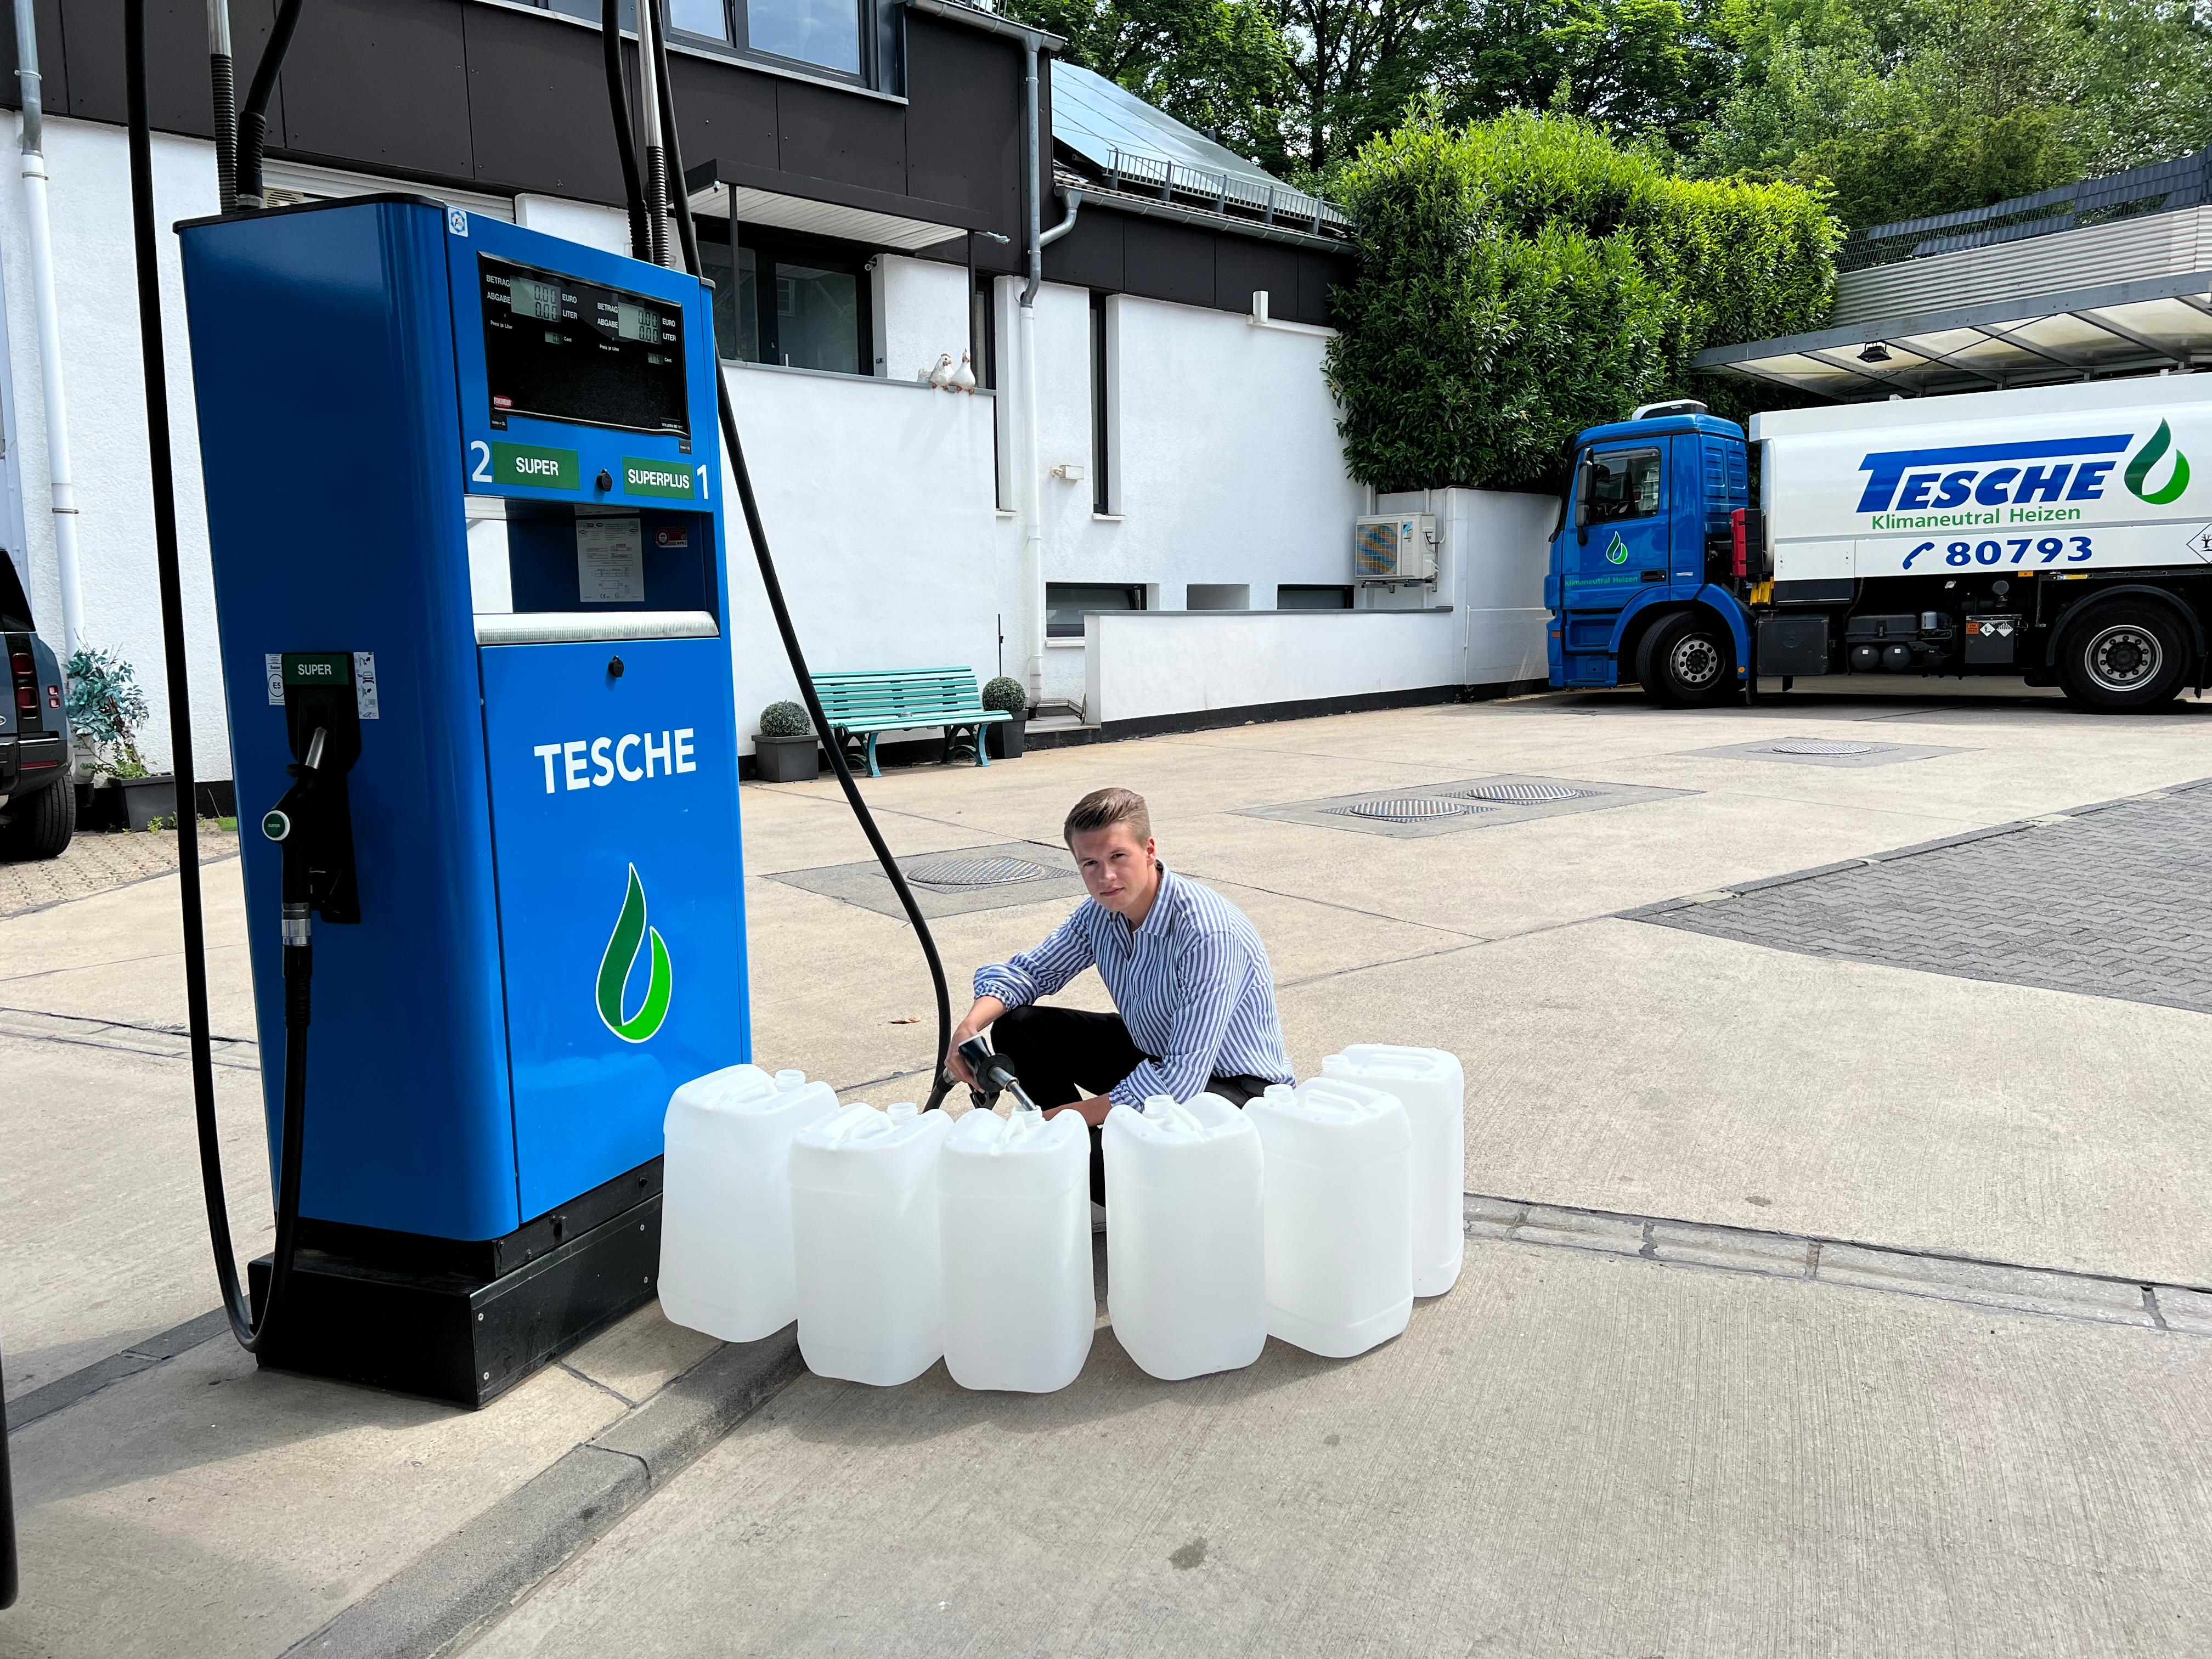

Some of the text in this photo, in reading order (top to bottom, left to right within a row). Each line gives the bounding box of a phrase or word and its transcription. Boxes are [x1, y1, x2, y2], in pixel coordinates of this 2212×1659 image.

[486, 274, 510, 287] BETRAG
[562, 293, 577, 303] EURO
[487, 291, 511, 303] ABGABE
[562, 309, 578, 319] LITER
[597, 302, 676, 328] BETRAG 0.00 EURO
[597, 318, 676, 343] ABGABE 0.00 LITER
[470, 440, 493, 483] 2
[515, 456, 558, 476] SUPER
[1855, 433, 2135, 513] TESCHE
[628, 469, 690, 489] SUPERPLUS
[696, 464, 709, 500] 1
[1871, 506, 2080, 529] Klimaneutral Heizen
[1945, 536, 2092, 567] 80793
[1565, 577, 1610, 586] Klimaneutral
[298, 664, 332, 675] SUPER
[534, 727, 696, 794] TESCHE
